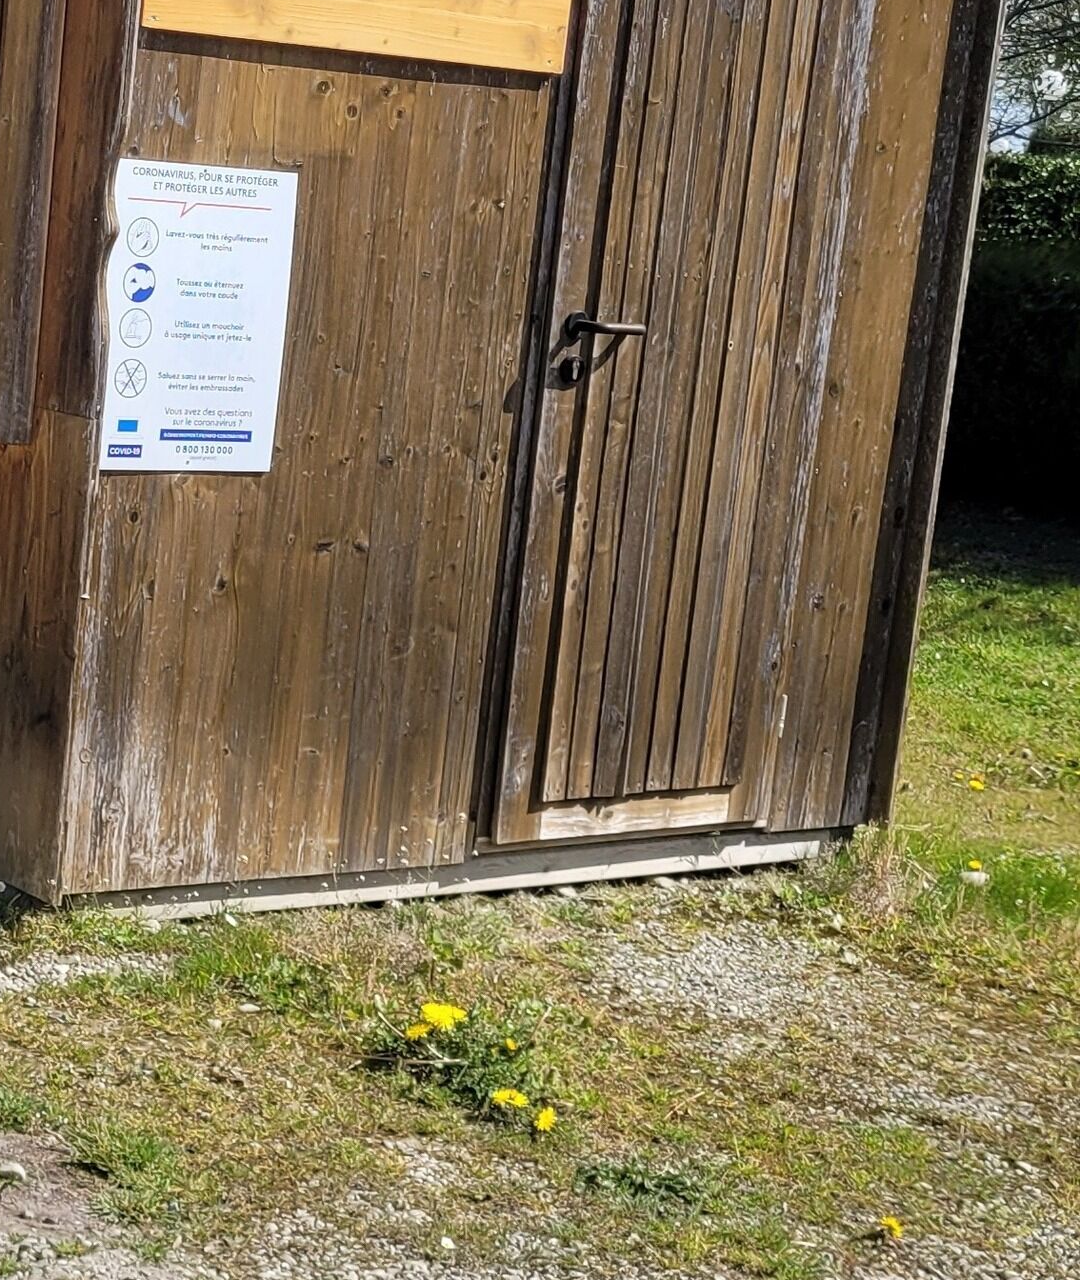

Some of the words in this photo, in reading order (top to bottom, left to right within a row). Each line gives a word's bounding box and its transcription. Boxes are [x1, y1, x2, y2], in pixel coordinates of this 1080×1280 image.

[132, 166, 197, 181] CORONAVIRUS,
[199, 172, 223, 182] POUR
[224, 174, 234, 184] SE
[236, 175, 279, 187] PROTÉGER
[153, 181, 163, 190] ET
[165, 182, 208, 194] PROTÉGER
[210, 186, 224, 196] LES
[225, 187, 257, 198] AUTRES
[165, 229, 205, 240] Lavez-vous
[206, 232, 219, 241] très
[201, 243, 210, 251] les
[212, 244, 233, 252] mains
[177, 278, 202, 287] Toussez
[204, 280, 213, 288] ou
[214, 280, 244, 289] éternuez
[180, 289, 197, 297] dans
[218, 291, 238, 300] coude
[174, 320, 200, 329] Utilisez
[212, 322, 244, 331] mouchoir
[171, 332, 191, 341] usage
[192, 332, 216, 341] unique
[208, 374, 227, 382] serrer
[189, 383, 198, 391] les
[164, 407, 182, 416] Vous
[184, 408, 201, 416] avez
[202, 408, 216, 416] des
[217, 408, 253, 418] questions
[172, 418, 184, 426] sur
[185, 418, 192, 426] le
[193, 419, 236, 427] coronavirus
[109, 447, 141, 456] COVID-19
[200, 445, 215, 454] 130
[216, 446, 233, 455] 000
